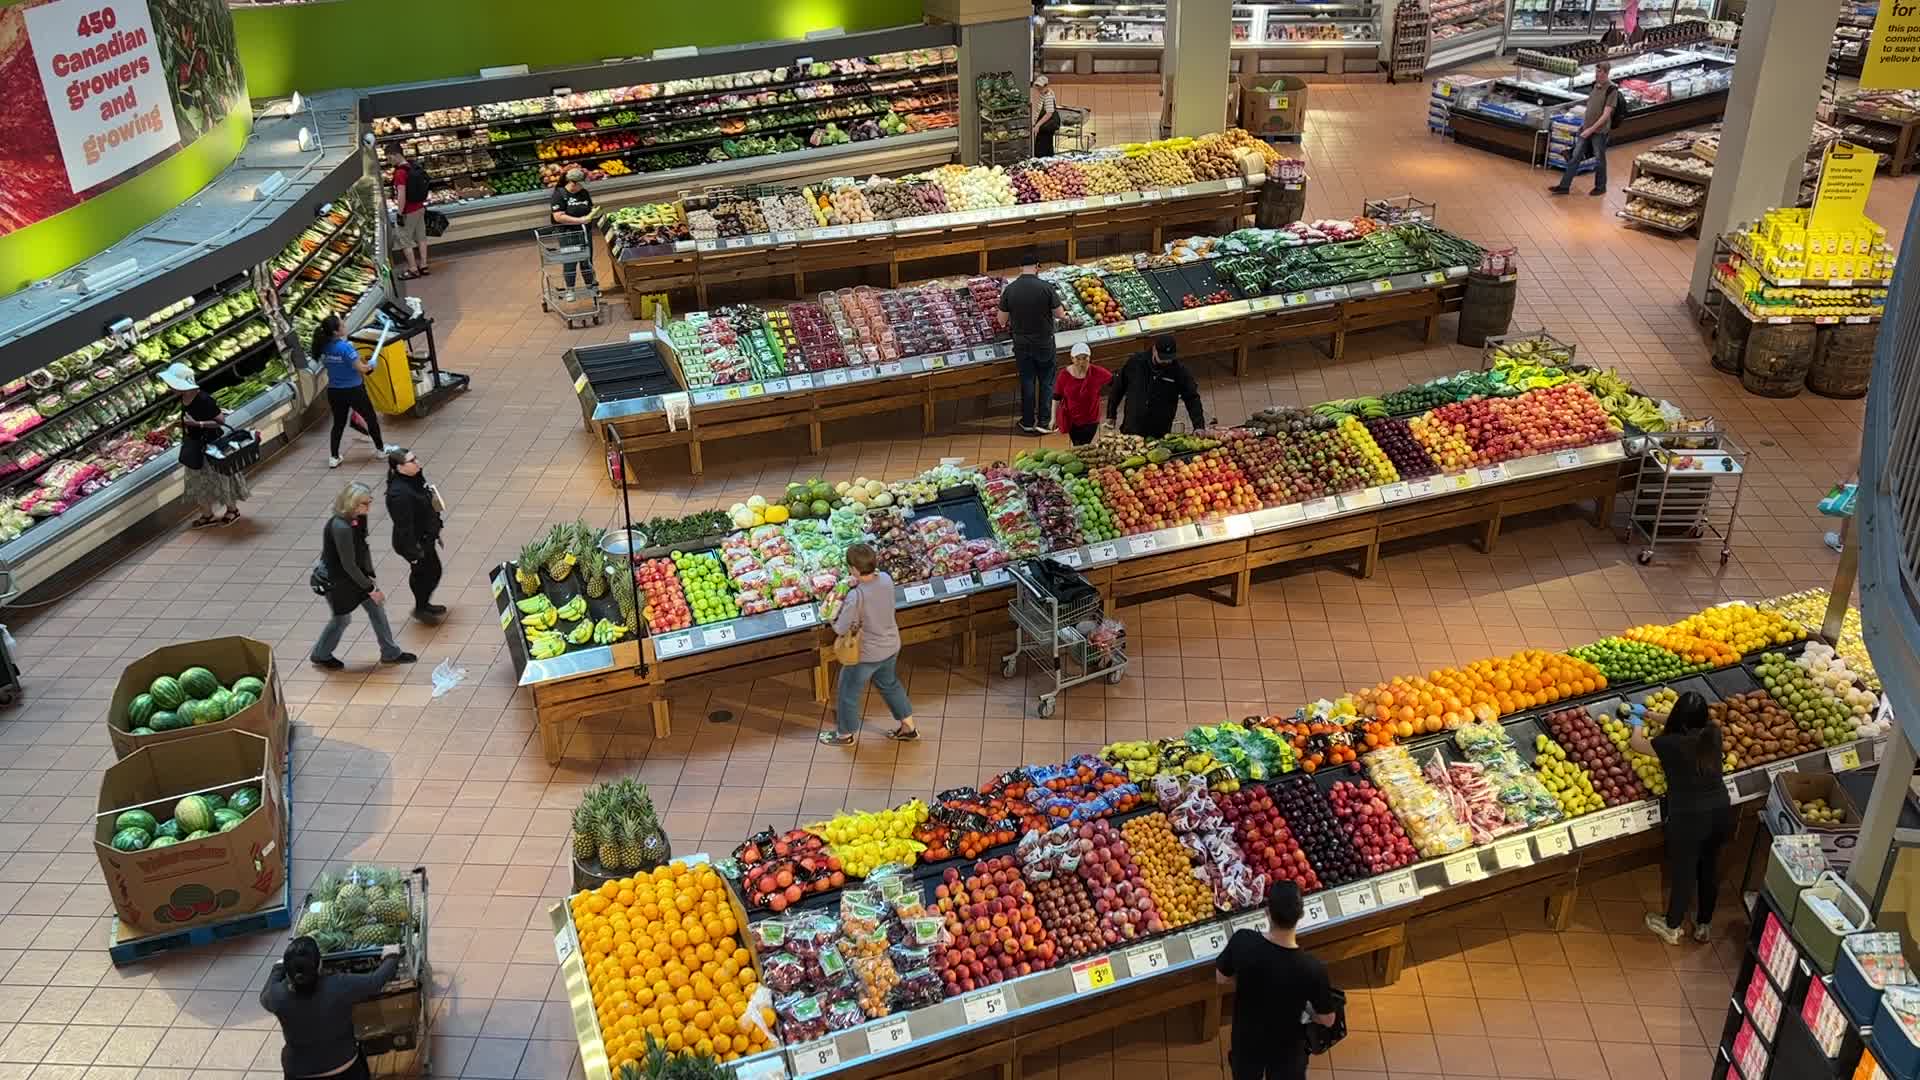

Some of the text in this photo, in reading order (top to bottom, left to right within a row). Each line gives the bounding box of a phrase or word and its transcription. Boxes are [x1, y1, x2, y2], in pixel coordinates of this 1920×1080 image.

[77, 7, 116, 37] 450
[1892, 3, 1917, 16] for
[1888, 24, 1905, 32] this
[52, 27, 148, 78] Canadian
[1880, 55, 1910, 63] yellow
[66, 56, 150, 111] growers
[100, 85, 137, 121] and
[83, 104, 163, 165] growing
